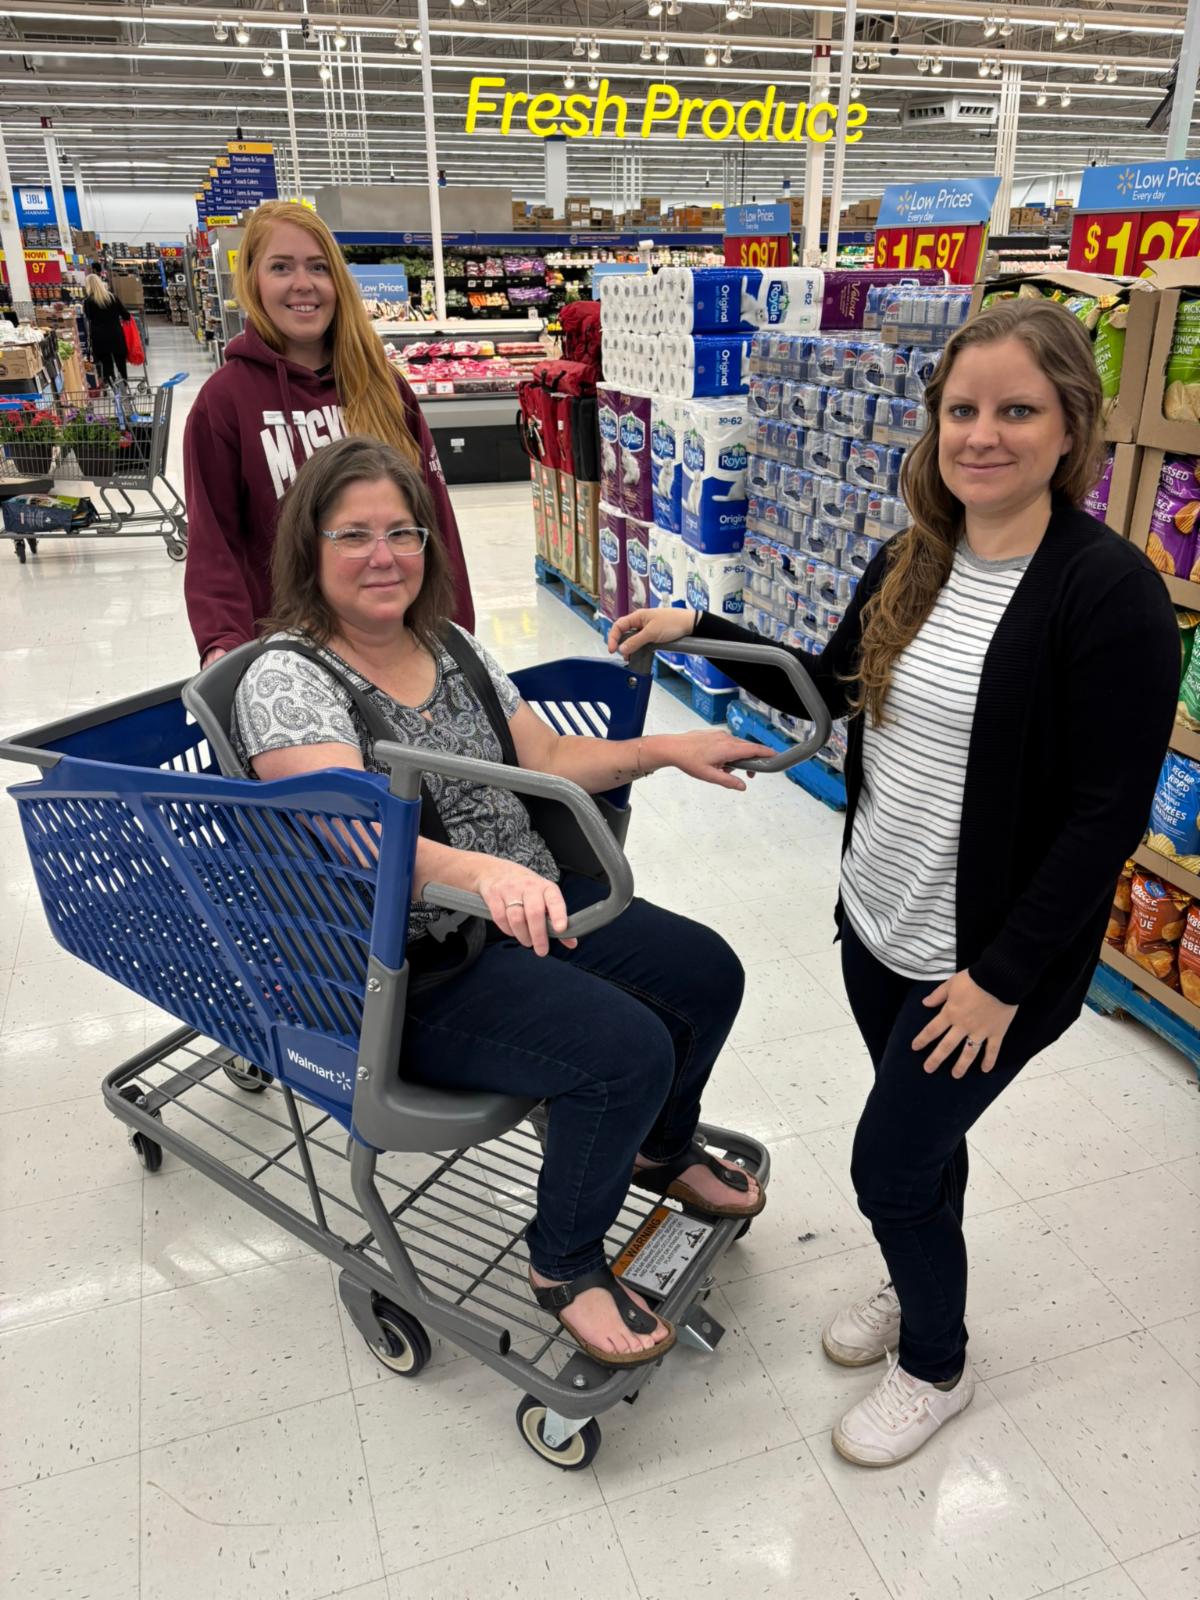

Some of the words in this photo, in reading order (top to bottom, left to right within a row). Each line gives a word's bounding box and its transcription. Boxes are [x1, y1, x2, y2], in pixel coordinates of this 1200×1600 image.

[466, 77, 628, 138] Fresh
[641, 84, 868, 143] Produce
[1134, 169, 1165, 190] Low
[1166, 166, 1200, 188] Price
[25, 193, 43, 205] JBL
[910, 191, 935, 211] Low
[936, 188, 974, 209] Prices
[1132, 190, 1152, 202] Every
[1153, 189, 1166, 201] day
[745, 210, 756, 222] Low
[757, 208, 775, 222] Prices
[907, 211, 923, 222] Every
[923, 211, 934, 223] day
[31, 262, 46, 274] 97
[359, 283, 378, 292] Low
[378, 282, 404, 292] Prices
[720, 284, 730, 323] Original
[770, 284, 781, 322] Royale
[720, 349, 730, 386] Original
[721, 456, 747, 469] Roya
[719, 514, 747, 526] Origin
[725, 600, 744, 612] Roy
[286, 1047, 335, 1083] Walmart
[624, 1216, 662, 1260] WARNING
